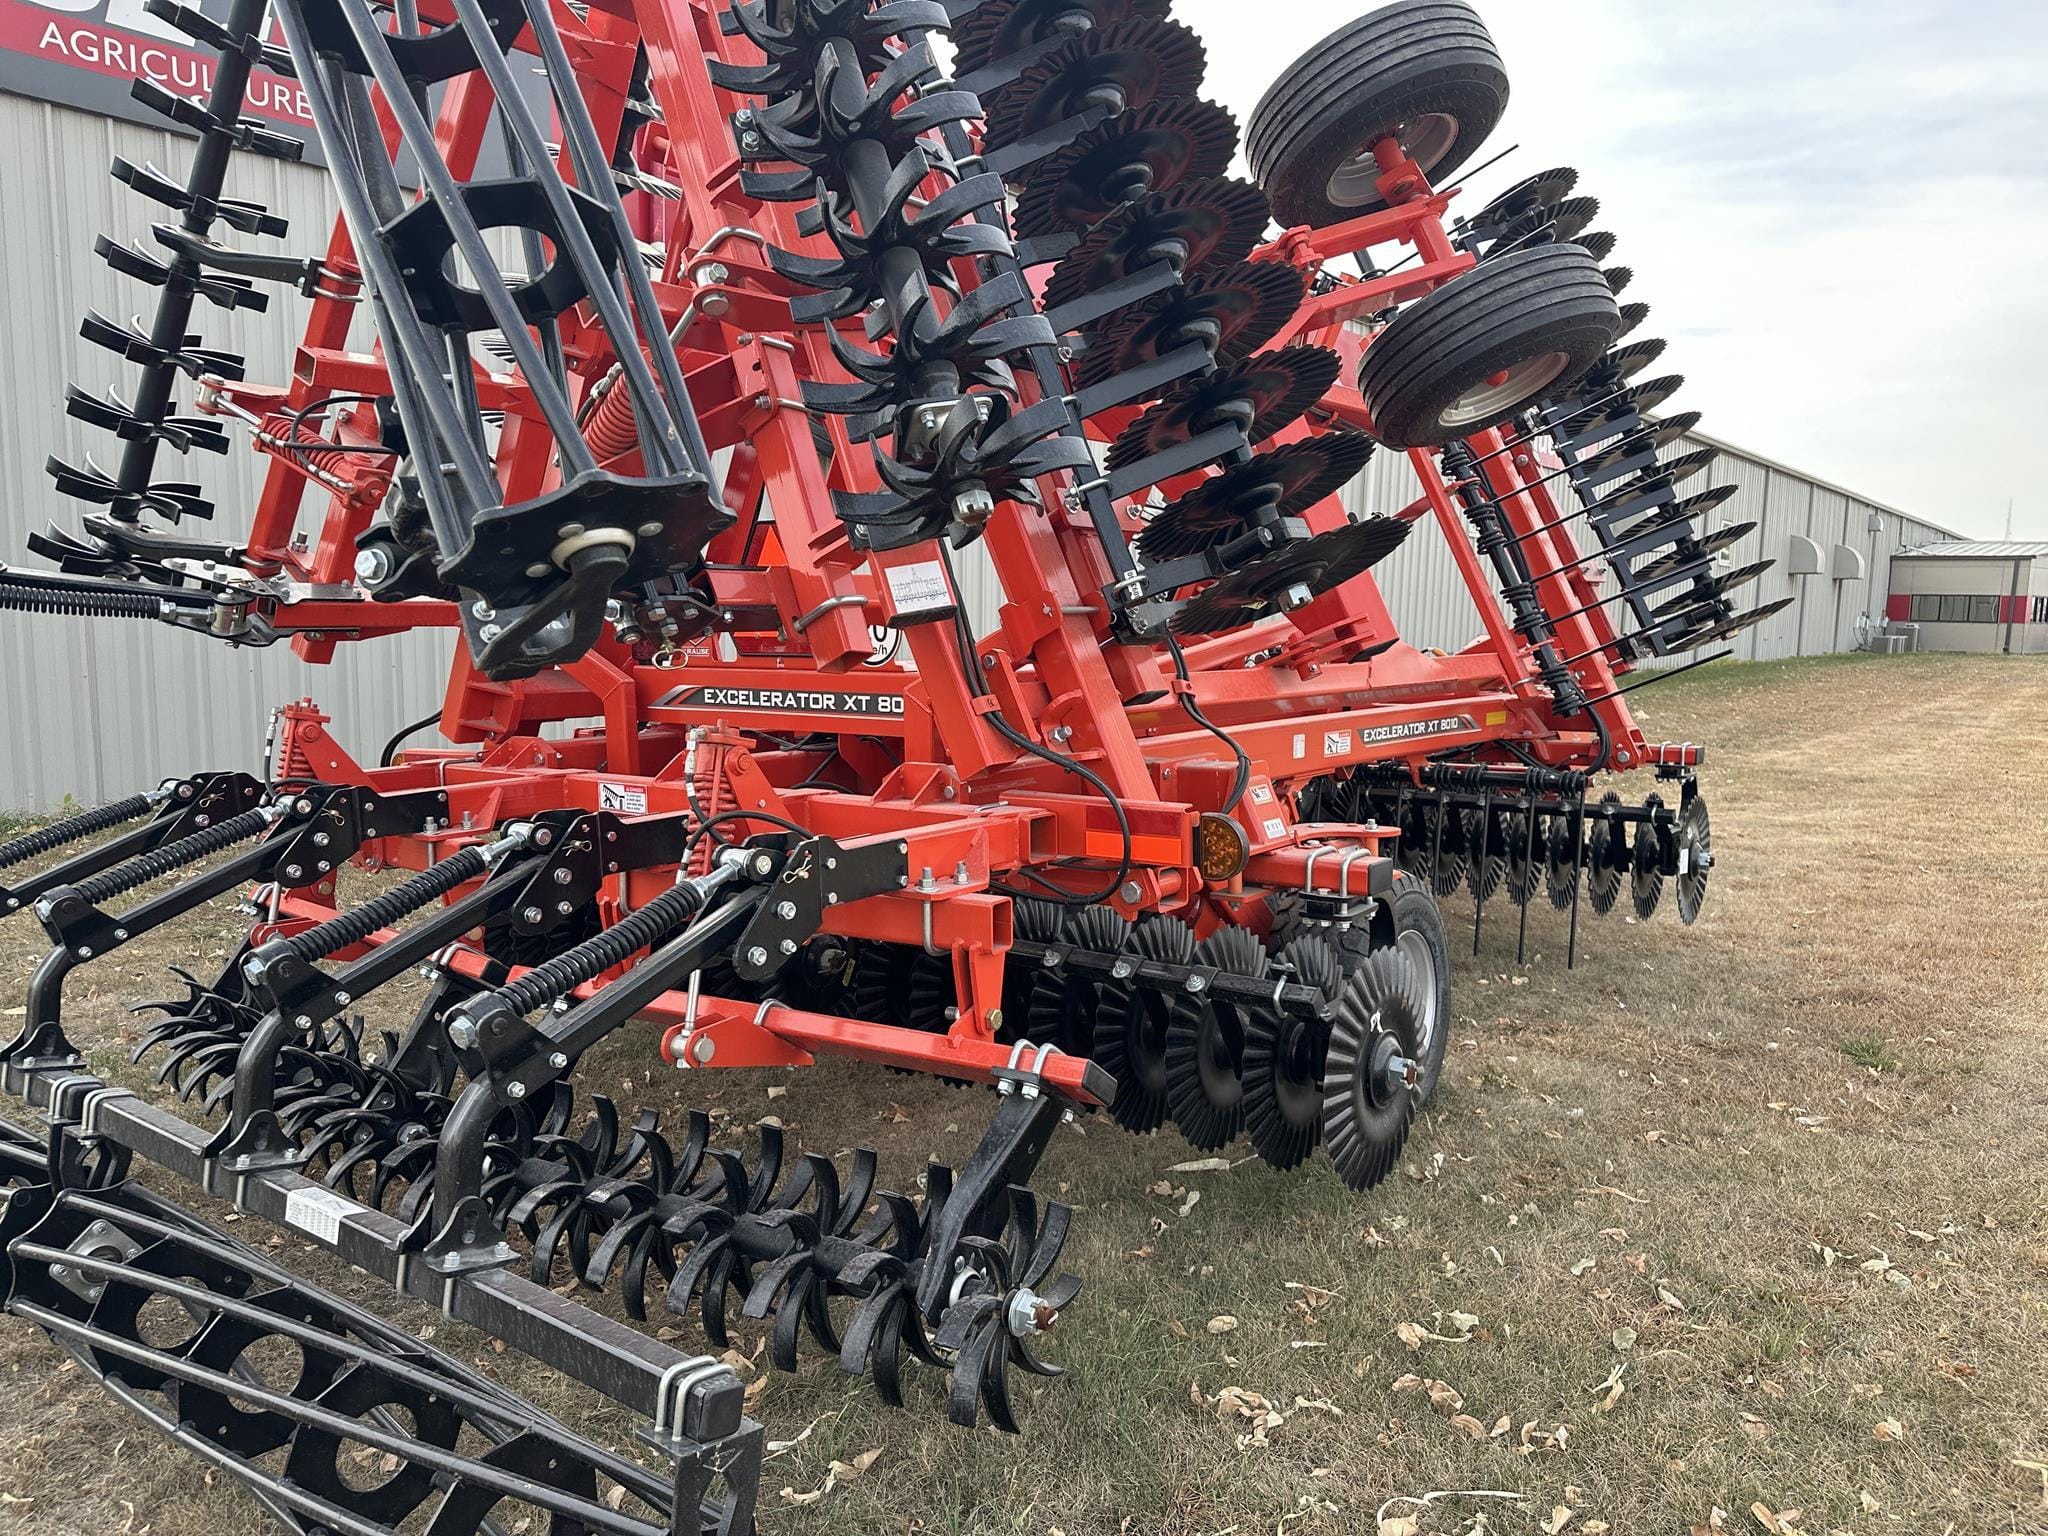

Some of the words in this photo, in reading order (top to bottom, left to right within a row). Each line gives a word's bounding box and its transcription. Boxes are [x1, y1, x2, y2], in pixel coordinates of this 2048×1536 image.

[38, 21, 313, 120] AGRICULURE
[704, 688, 836, 710] EXCELERATOR
[843, 694, 871, 711] XT
[878, 696, 904, 713] 80
[1363, 721, 1426, 742] EXCELERATOR
[1427, 720, 1440, 733] XT
[1441, 717, 1459, 730] 8010
